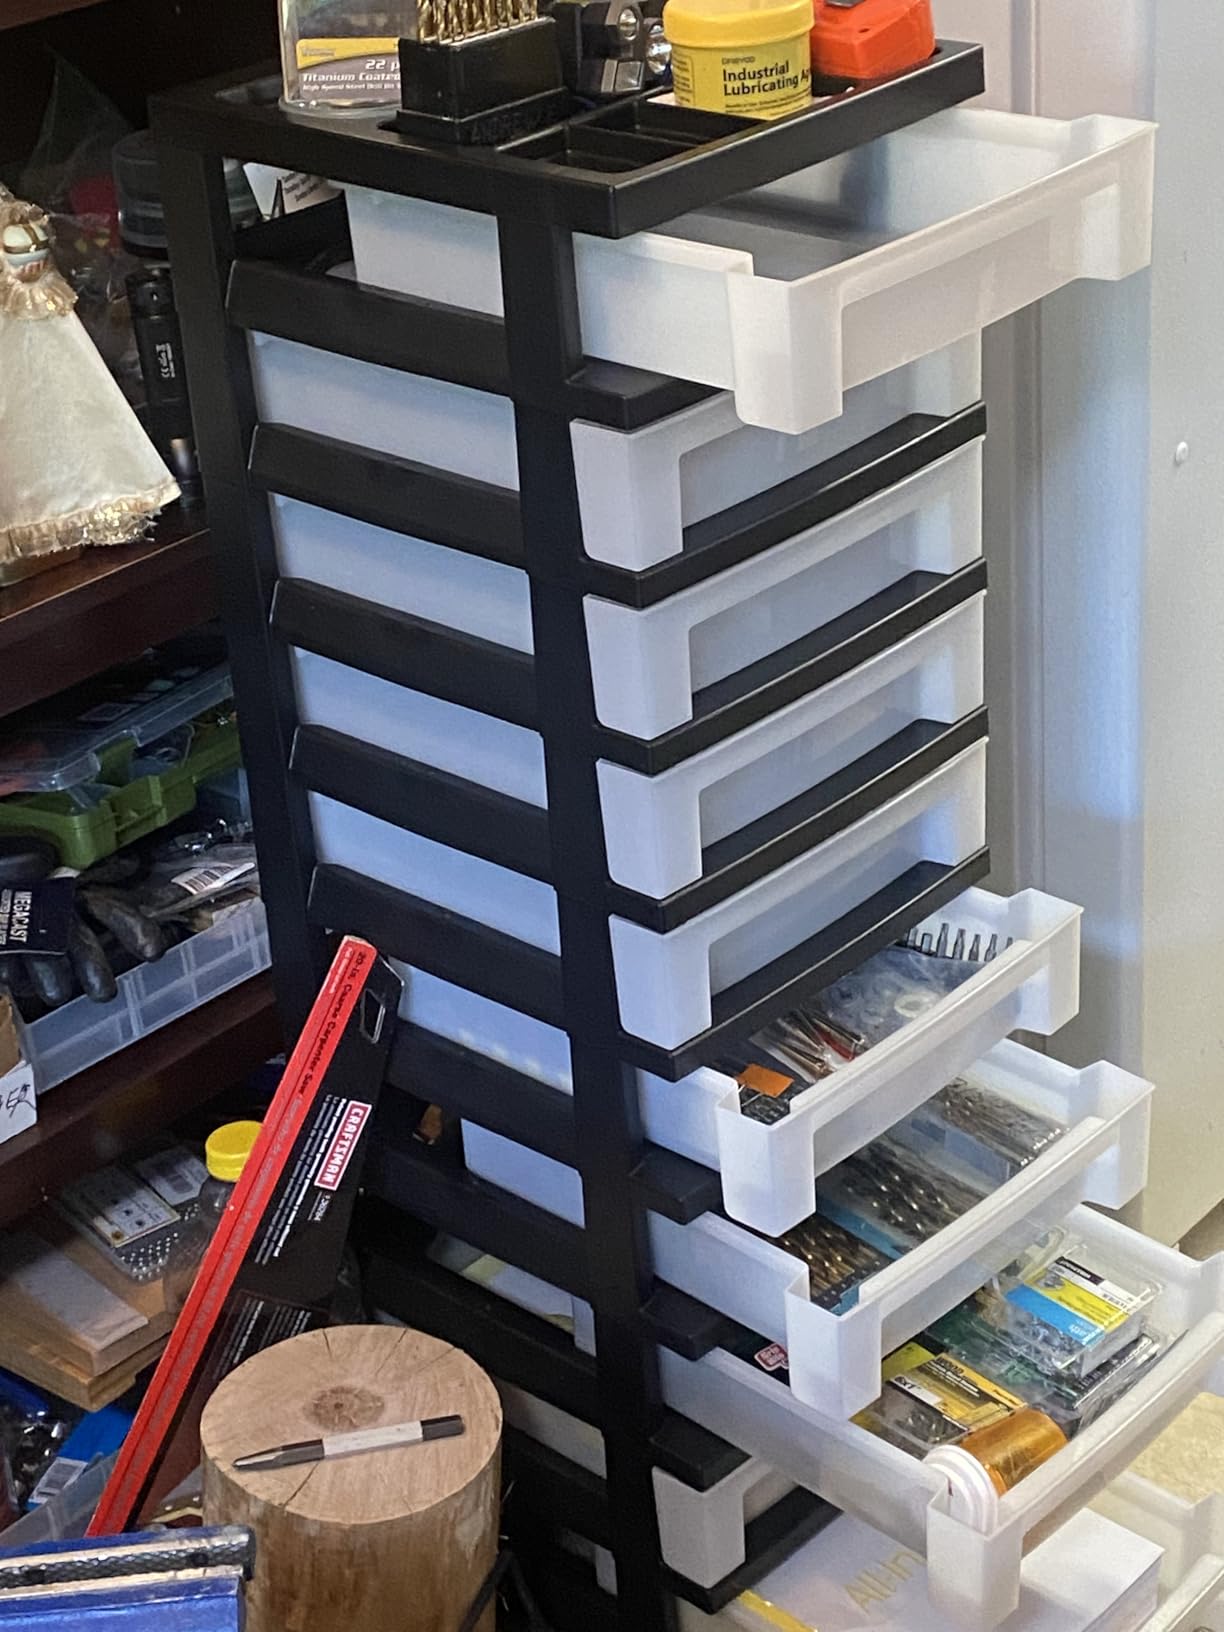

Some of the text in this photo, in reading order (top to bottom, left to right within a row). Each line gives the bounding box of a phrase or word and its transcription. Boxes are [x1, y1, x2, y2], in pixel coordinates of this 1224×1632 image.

[365, 60, 385, 70] 22
[723, 62, 789, 82] Industrial
[302, 73, 356, 83] Titanium
[724, 75, 798, 97] Lubricating
[9, 891, 32, 943] MEGACAST
[310, 1022, 336, 1072] Carpenter
[299, 1074, 313, 1095] Saw
[322, 1107, 364, 1184] CRAFTSMAN
